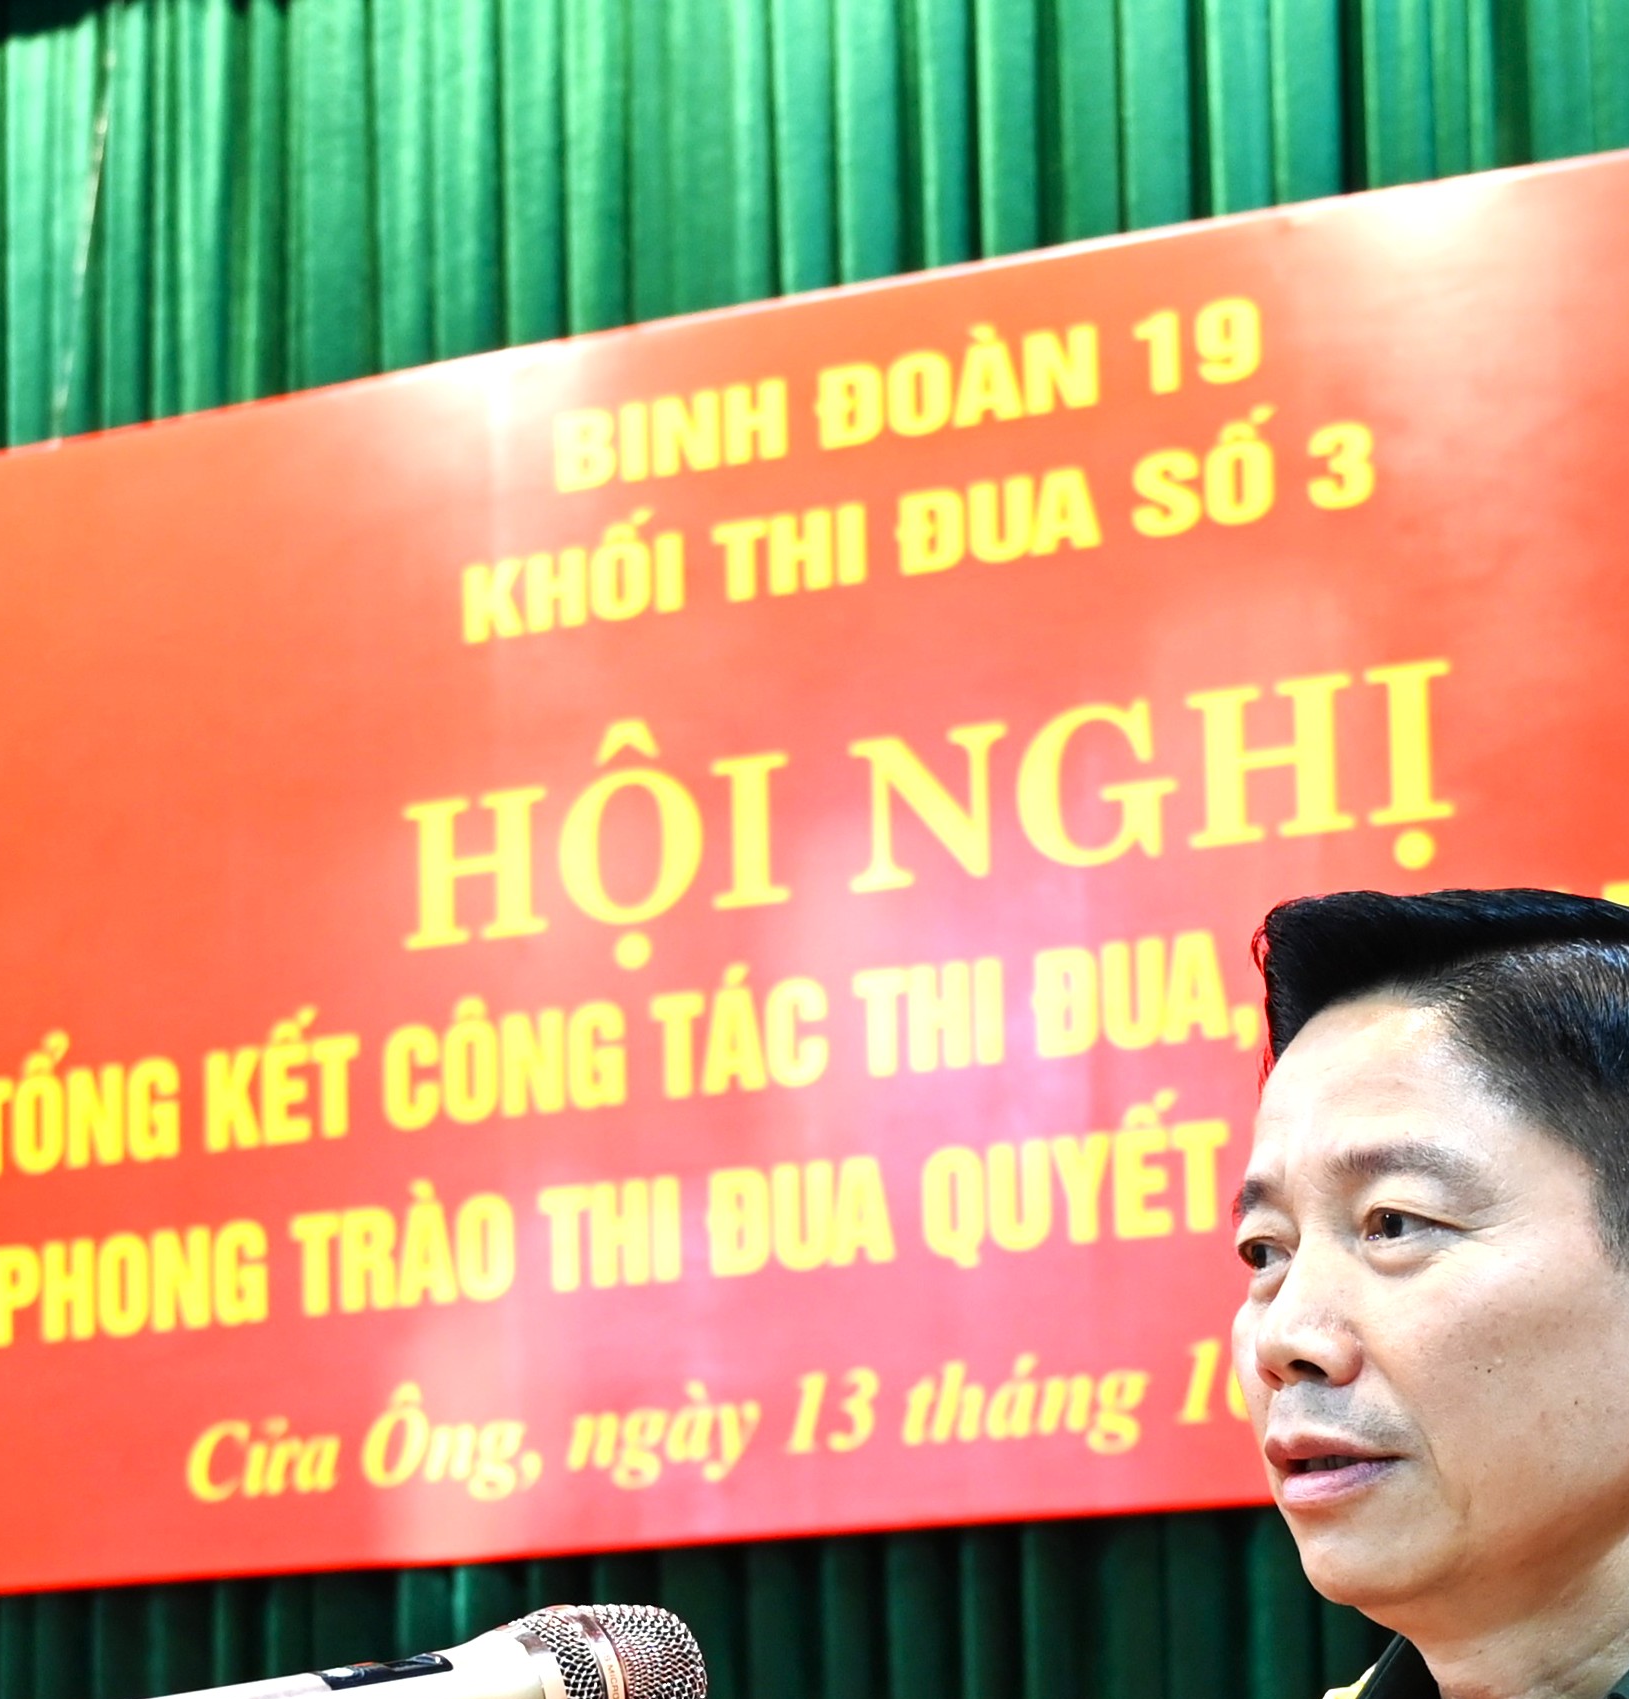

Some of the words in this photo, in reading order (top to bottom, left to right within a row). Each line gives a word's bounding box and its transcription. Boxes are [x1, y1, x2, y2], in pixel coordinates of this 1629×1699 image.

[553, 377, 789, 494] BINH
[813, 323, 1100, 450] ĐOÀN
[1134, 296, 1262, 394] 19
[462, 507, 685, 644] KHỐI
[711, 502, 867, 602] THI
[895, 467, 1102, 575] ĐUA
[1132, 405, 1275, 537] SỐ
[1308, 422, 1375, 510] 3
[405, 719, 789, 969] HỘI
[850, 660, 1454, 893] NGHỊ
[205, 1006, 359, 1151] KẾT
[384, 997, 626, 1130] CÔNG
[651, 963, 829, 1099] TÁC
[853, 957, 1004, 1077] THI
[1031, 930, 1259, 1059] ĐUA,
[292, 1181, 516, 1317] TRÀO
[538, 1176, 681, 1292] THI
[708, 1155, 895, 1276] ĐUA
[921, 1090, 1229, 1268] QUYẾT
[188, 1417, 340, 1501] Cửa
[362, 1382, 542, 1501] Ông,
[567, 1380, 761, 1489] ngày
[789, 1370, 879, 1453] 13
[903, 1355, 1148, 1453] tháng
